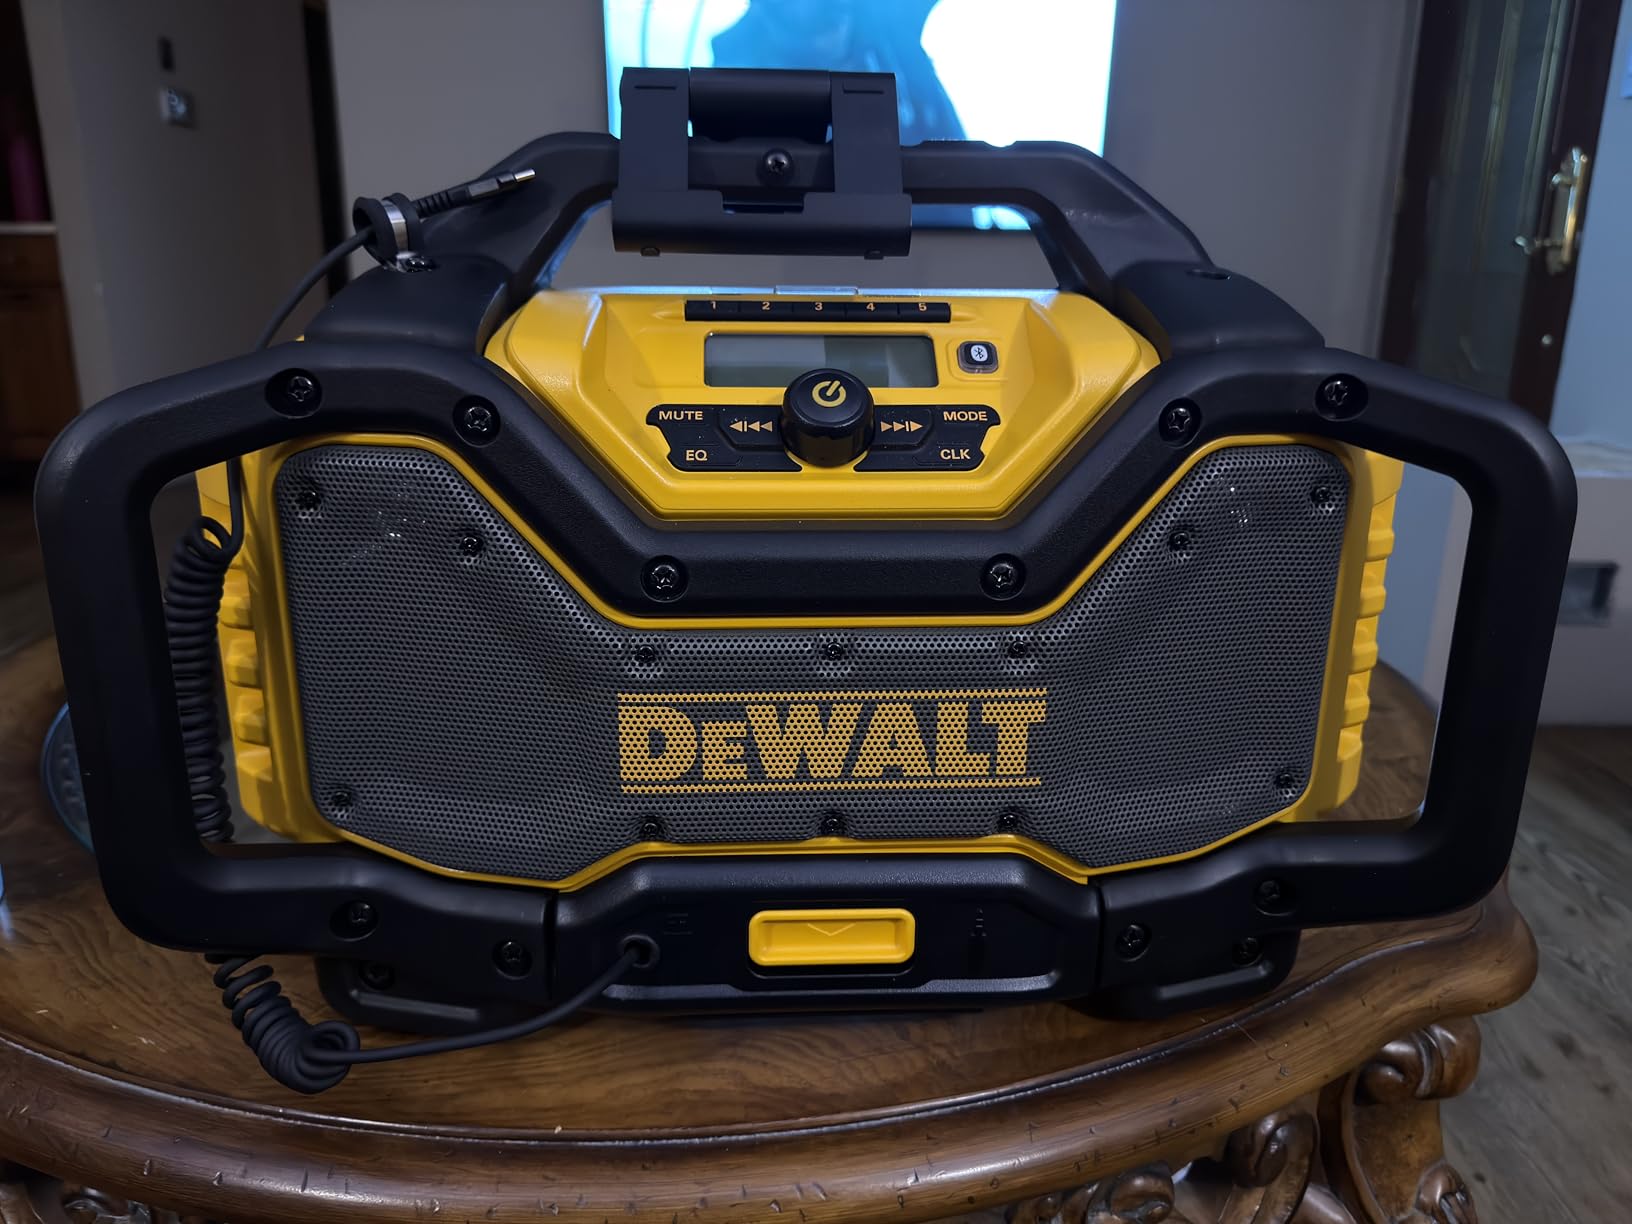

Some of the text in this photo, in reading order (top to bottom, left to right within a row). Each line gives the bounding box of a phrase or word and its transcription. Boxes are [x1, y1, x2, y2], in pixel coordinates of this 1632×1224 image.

[710, 302, 927, 311] 1 2 3 4 5
[658, 410, 704, 421] MUTE
[943, 411, 988, 422] MODE
[685, 450, 708, 462] EQ
[940, 449, 971, 460] CLK
